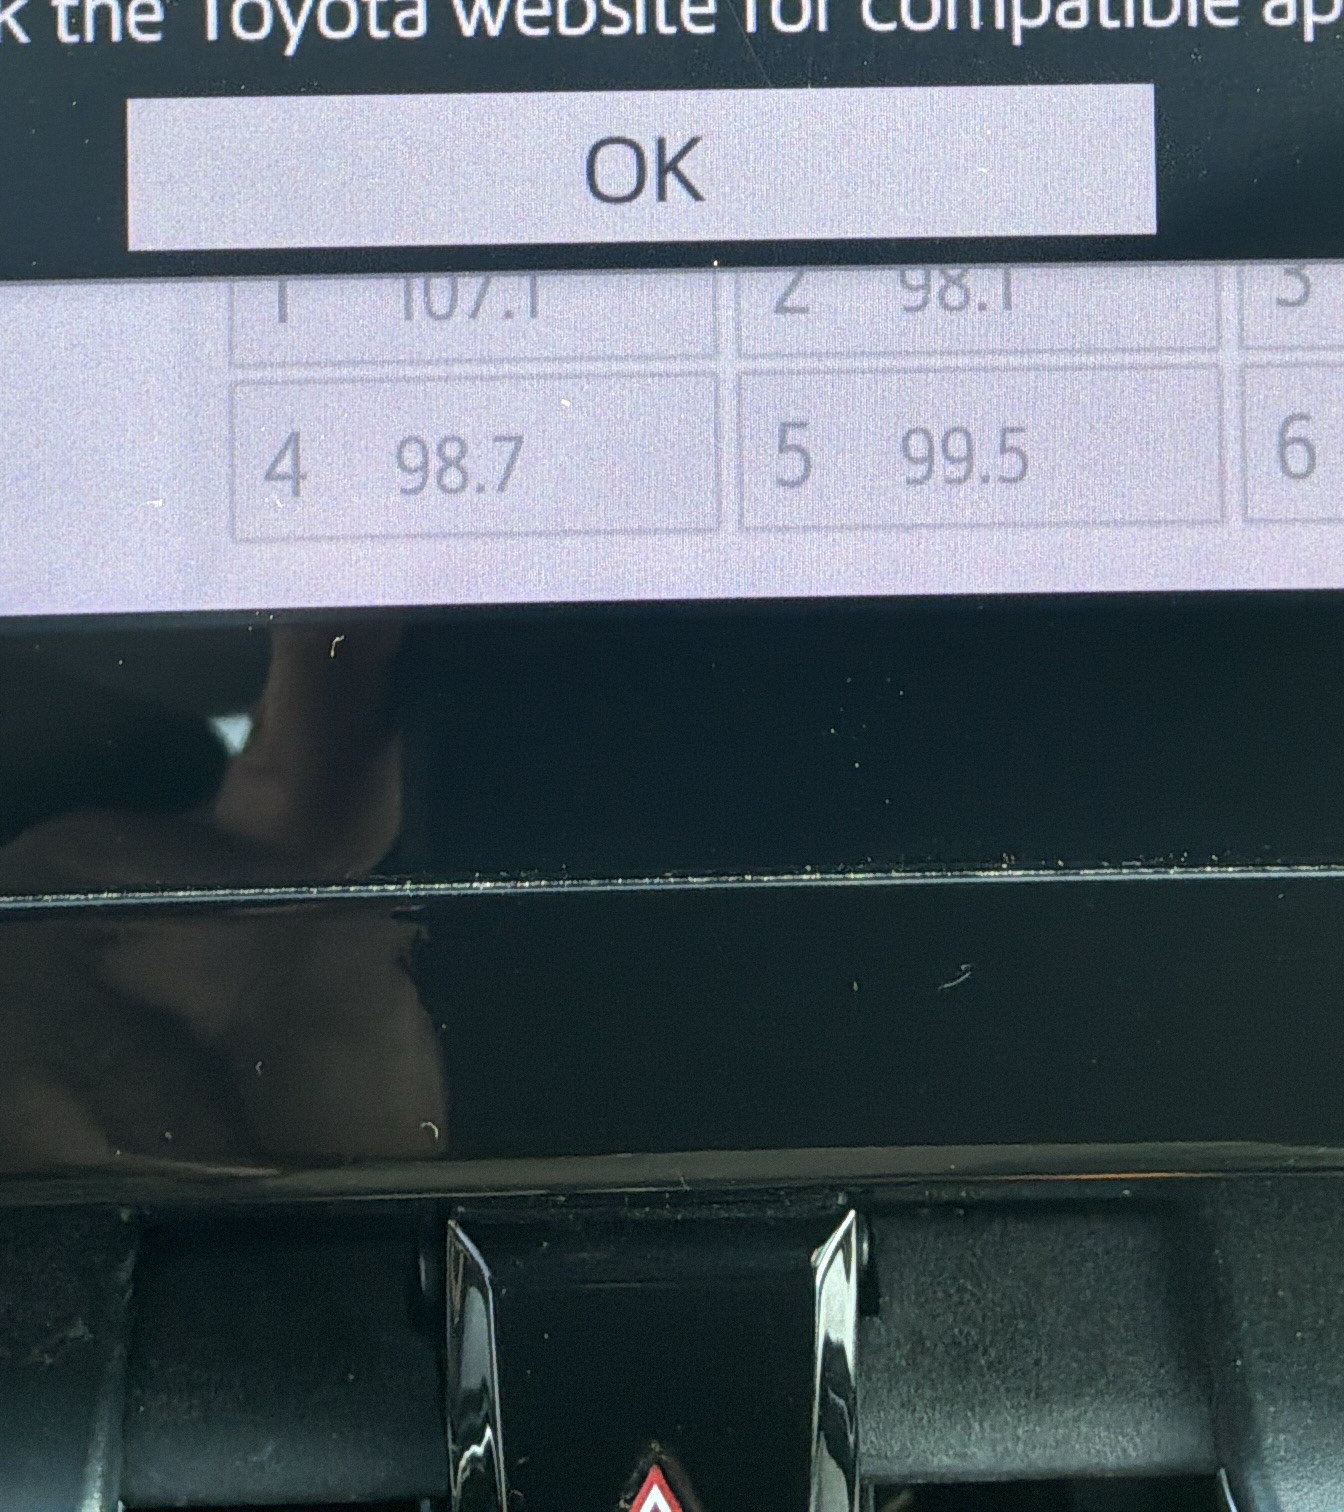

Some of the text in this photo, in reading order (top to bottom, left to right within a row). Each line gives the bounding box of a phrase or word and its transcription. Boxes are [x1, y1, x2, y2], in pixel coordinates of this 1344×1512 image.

[584, 135, 704, 206] OK
[263, 430, 525, 498] 4 98.7
[775, 420, 1030, 489] 5 99.5
[1276, 411, 1318, 482] 6
